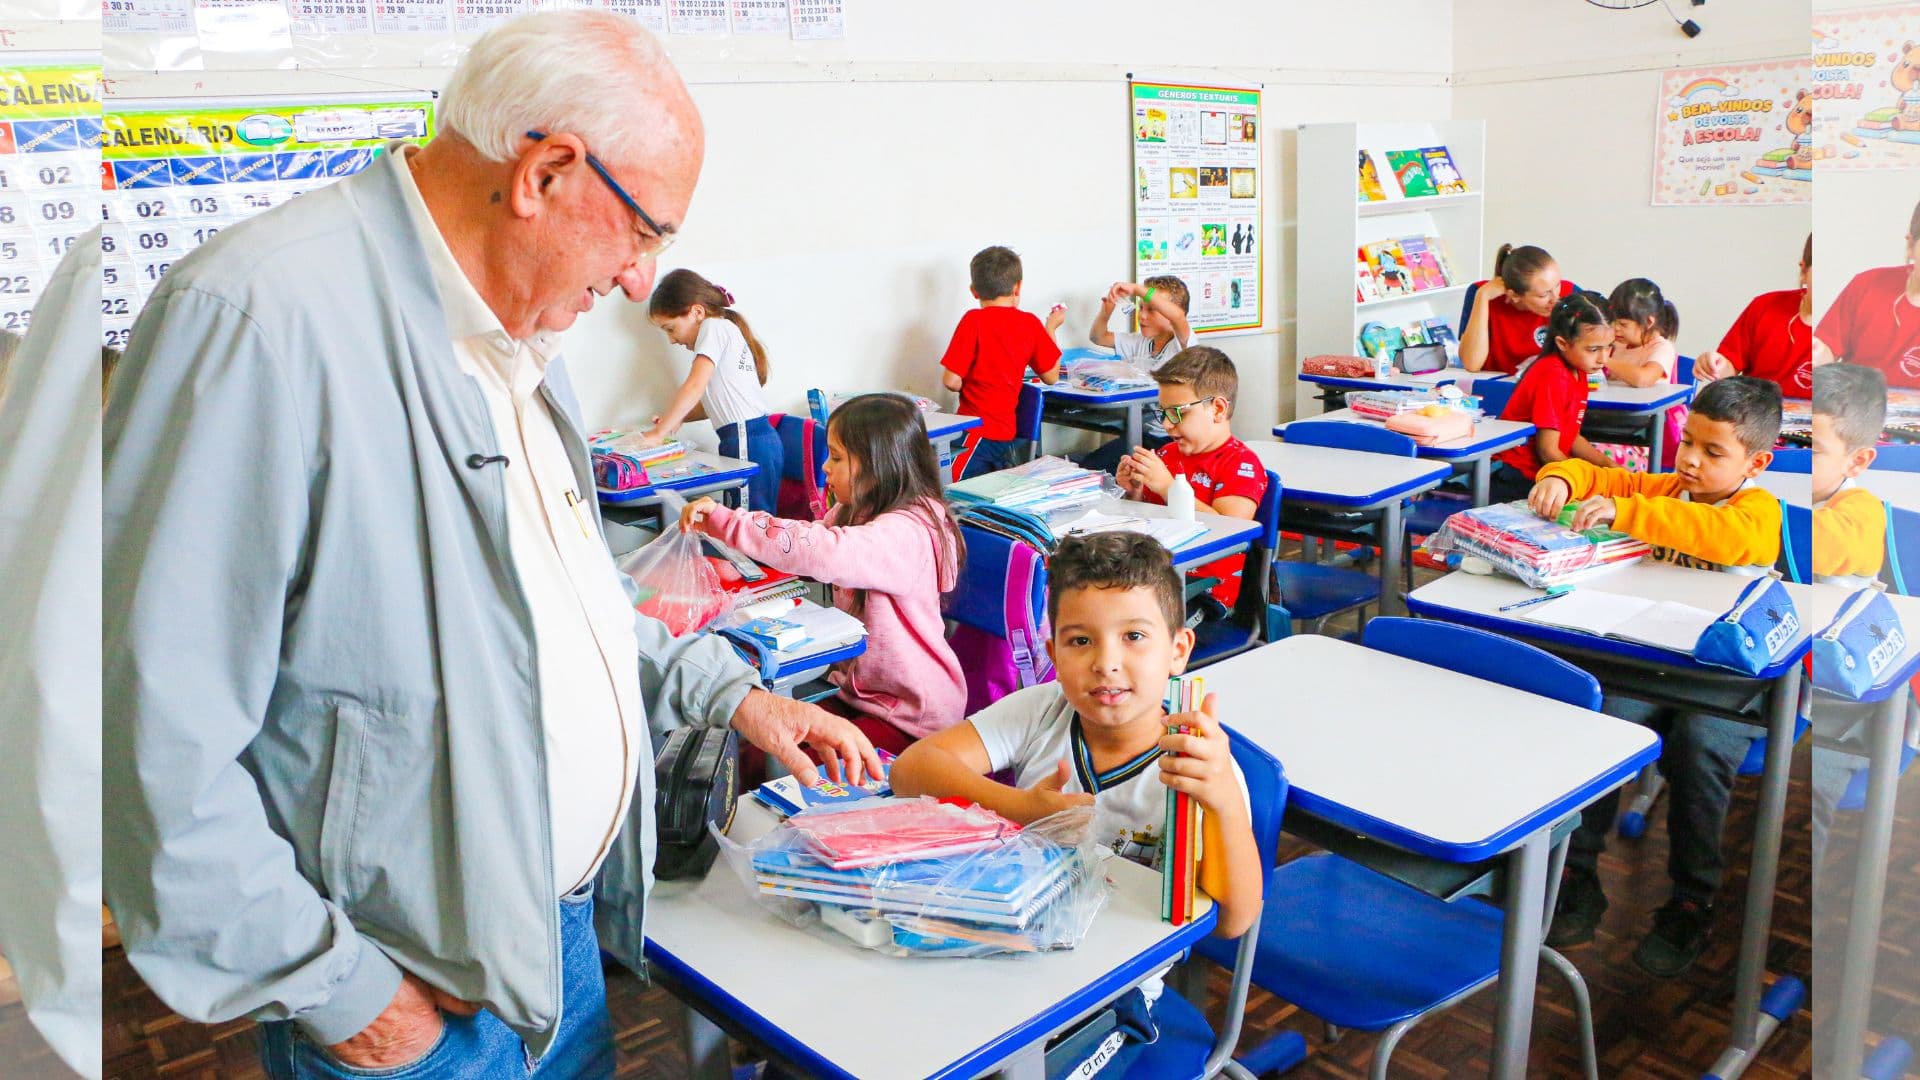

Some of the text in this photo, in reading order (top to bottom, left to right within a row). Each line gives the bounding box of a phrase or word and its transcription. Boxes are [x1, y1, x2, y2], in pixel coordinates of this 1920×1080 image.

[111, 1, 121, 10] 30
[125, 2, 135, 11] 31
[303, 5, 366, 13] 25 26 27 28 29 30
[376, 6, 405, 14] 28 29 30
[457, 6, 512, 14] 26 27 28 29 30 31
[1158, 89, 1239, 102] GÊNEROS TEXTUAIS
[1681, 98, 1773, 119] BEM-VINDOS
[1695, 114, 1750, 128] DE VOLTA
[1683, 126, 1762, 147] À ESCOLA!
[1678, 155, 1693, 164] Que
[39, 167, 72, 185] 02
[42, 201, 75, 221] 09
[136, 200, 166, 218] 02
[189, 197, 219, 214] 03
[139, 232, 169, 250] 09
[0, 276, 31, 294] 22
[102, 299, 129, 315] 22
